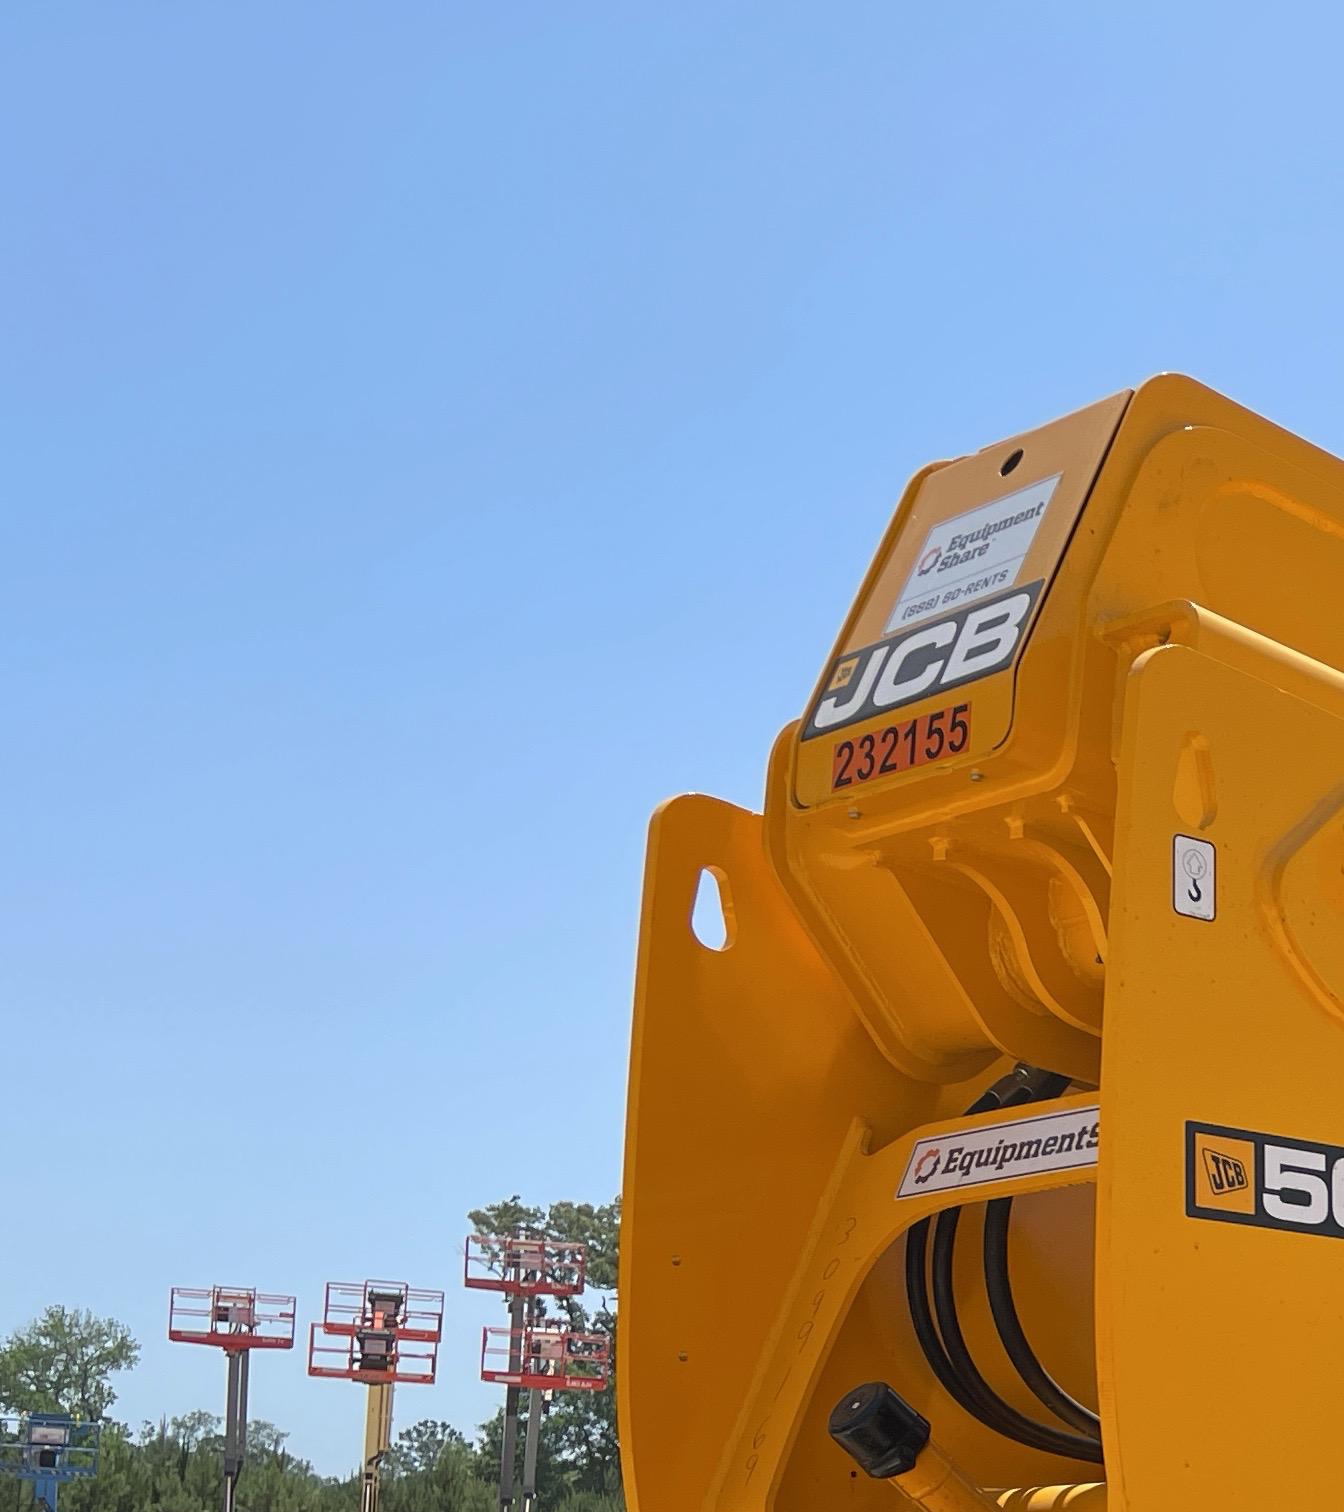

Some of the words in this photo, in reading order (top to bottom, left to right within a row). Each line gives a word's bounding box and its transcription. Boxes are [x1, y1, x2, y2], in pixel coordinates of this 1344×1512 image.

[946, 501, 1044, 553] Equipment
[936, 542, 990, 574] Share
[814, 592, 1031, 729] JCB
[833, 703, 970, 789] 232155
[1210, 1153, 1245, 1190] JCB
